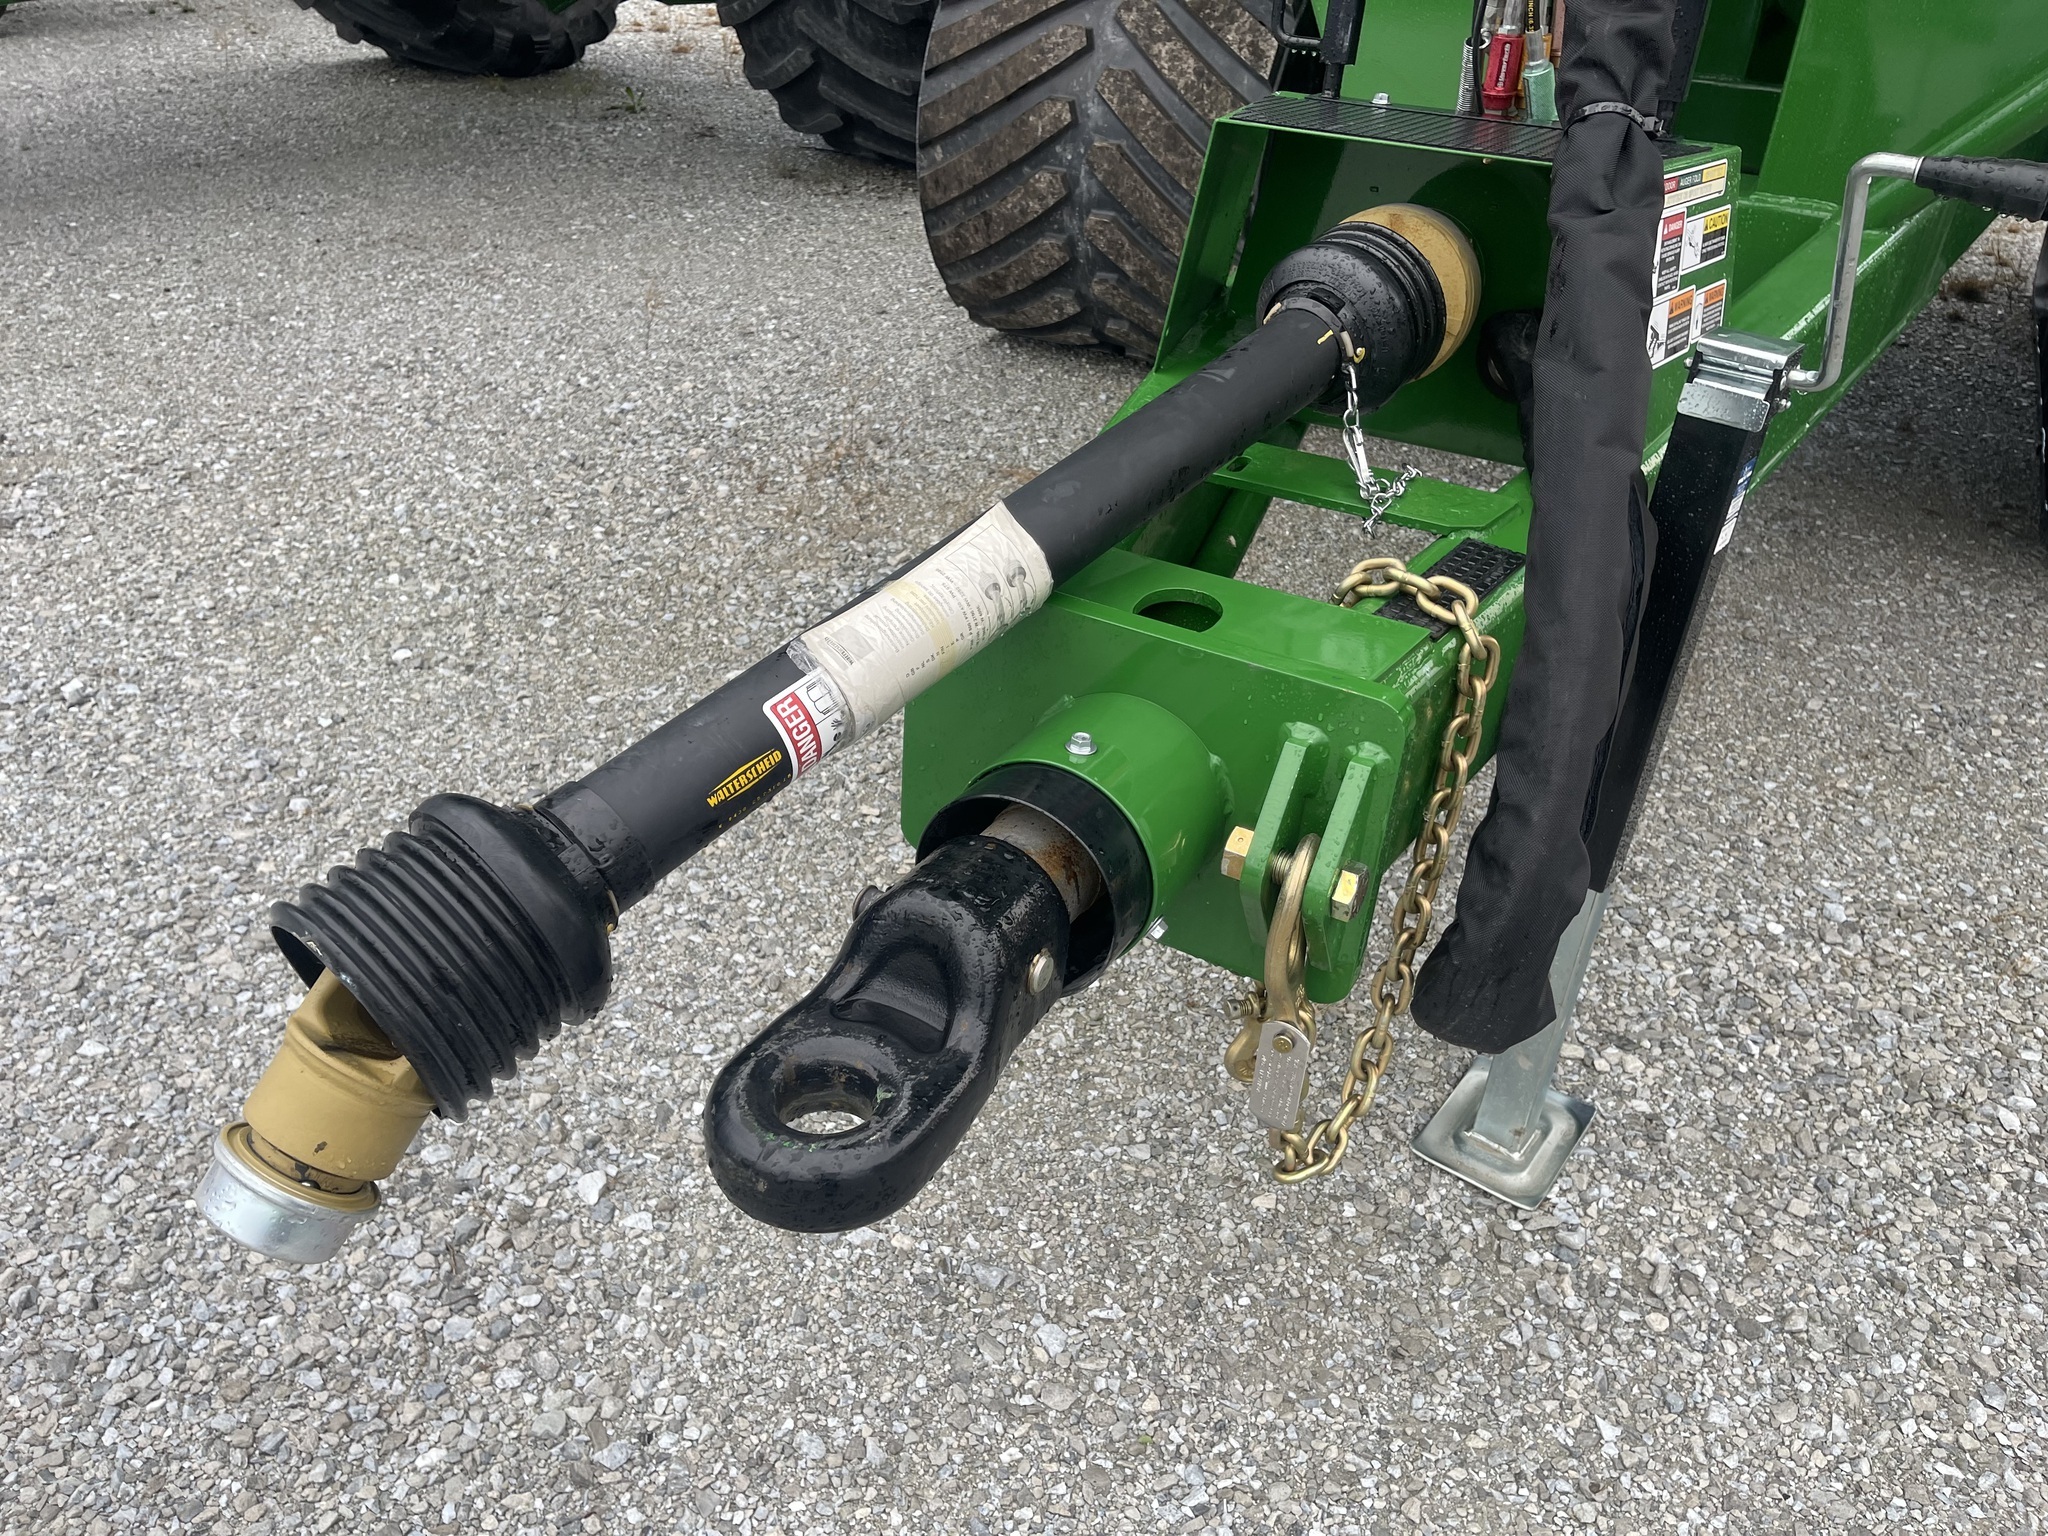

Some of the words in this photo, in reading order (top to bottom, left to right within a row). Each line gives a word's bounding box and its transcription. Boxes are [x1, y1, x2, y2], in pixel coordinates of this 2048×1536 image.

[1668, 220, 1683, 232] DANGER
[1708, 213, 1728, 230] CAUTION
[1674, 294, 1693, 311] WARNING
[1708, 286, 1724, 302] WARNING
[776, 696, 819, 773] DANGER
[706, 749, 782, 808] WALTERSCHEID
